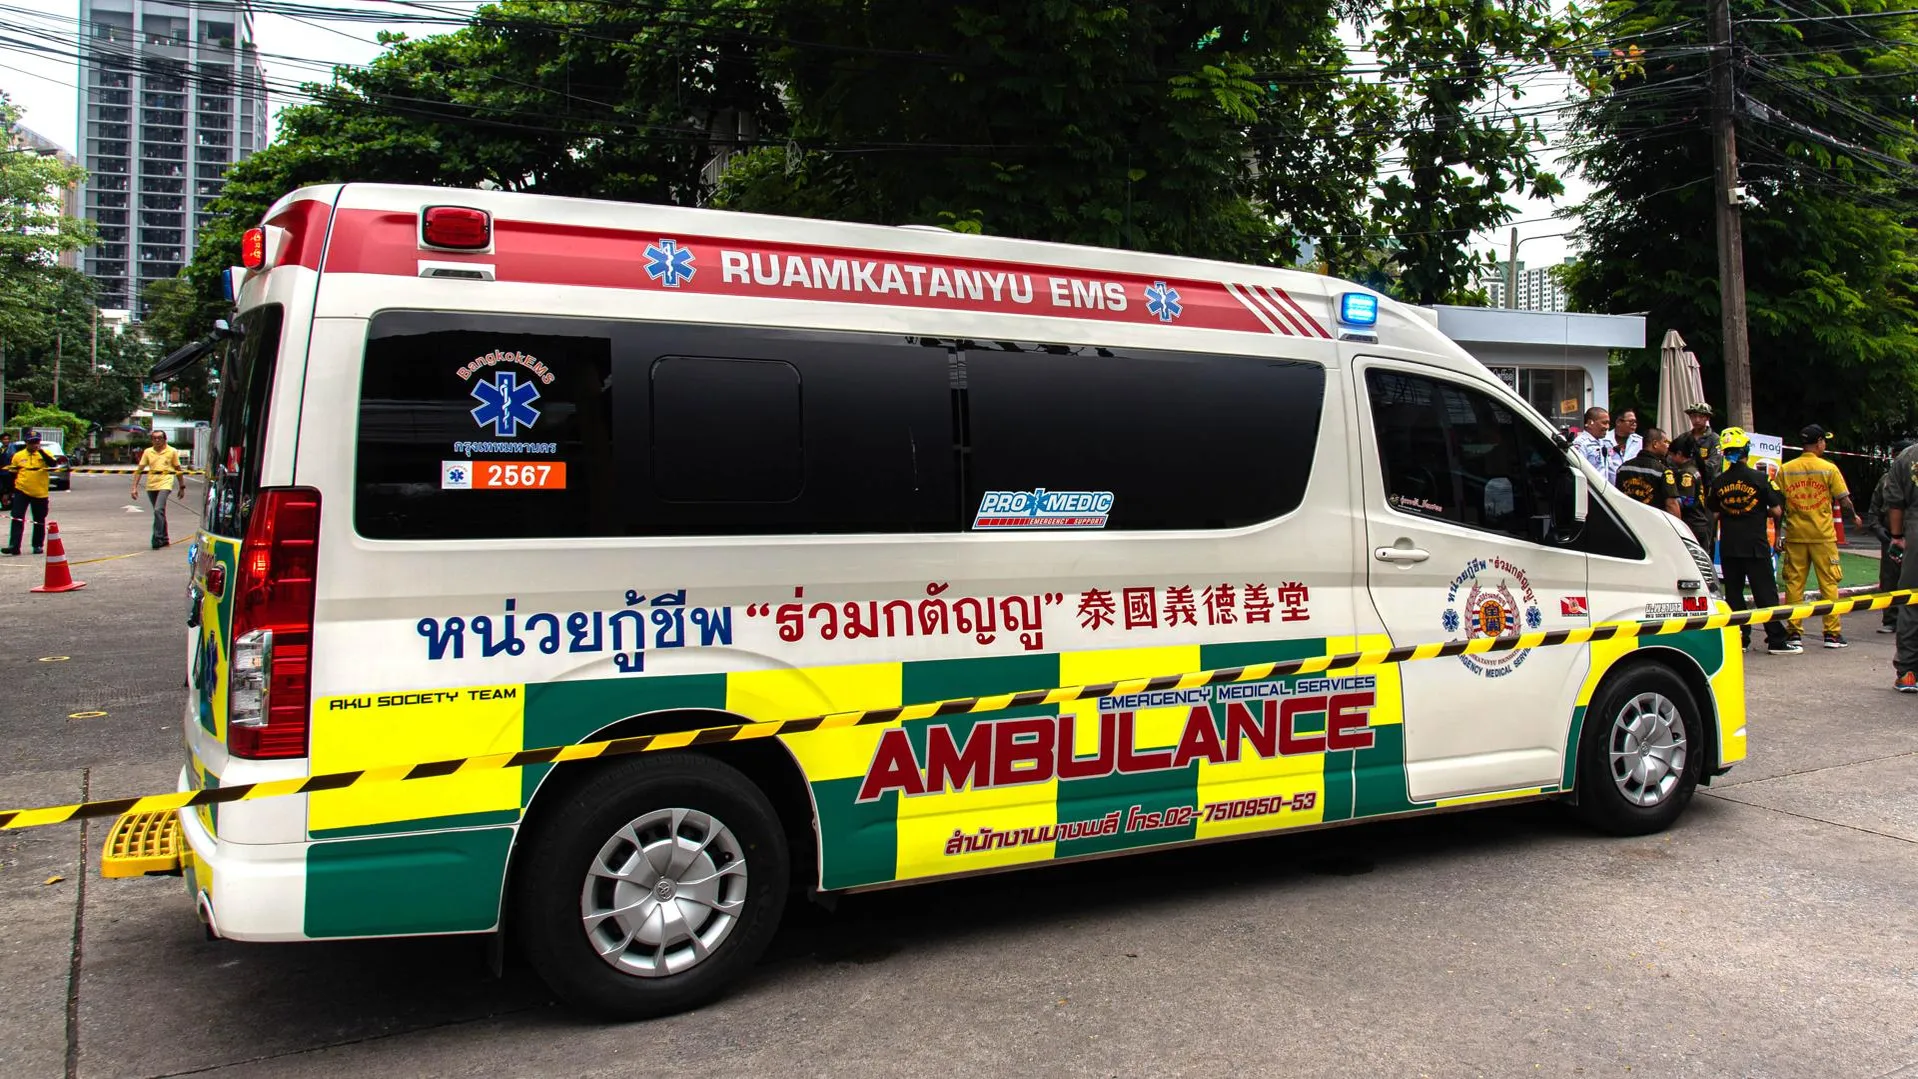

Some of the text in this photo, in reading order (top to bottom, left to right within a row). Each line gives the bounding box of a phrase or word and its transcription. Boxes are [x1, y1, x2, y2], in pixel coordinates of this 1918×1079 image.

[720, 249, 1128, 312] RUAMKATANYU EMS
[456, 349, 556, 385] BangkokEMS
[454, 441, 557, 458] กรุงเทพมหานคร
[487, 465, 552, 487] 2567
[981, 492, 1113, 513] PRO MEDIC
[1074, 517, 1104, 525] SUPPORT
[416, 588, 734, 674] หน่วยกู้ชีพ
[1076, 580, 1312, 631] 泰國義德善堂
[1485, 664, 1513, 678] MEDICAL
[378, 691, 459, 707] SOCIETY
[468, 688, 517, 701] TEAM
[1099, 676, 1376, 710] EMERGENCY MEDICAL SERVICES
[856, 691, 1376, 803] AMBULANCE
[944, 812, 1120, 857] สำนักงานบางพลี
